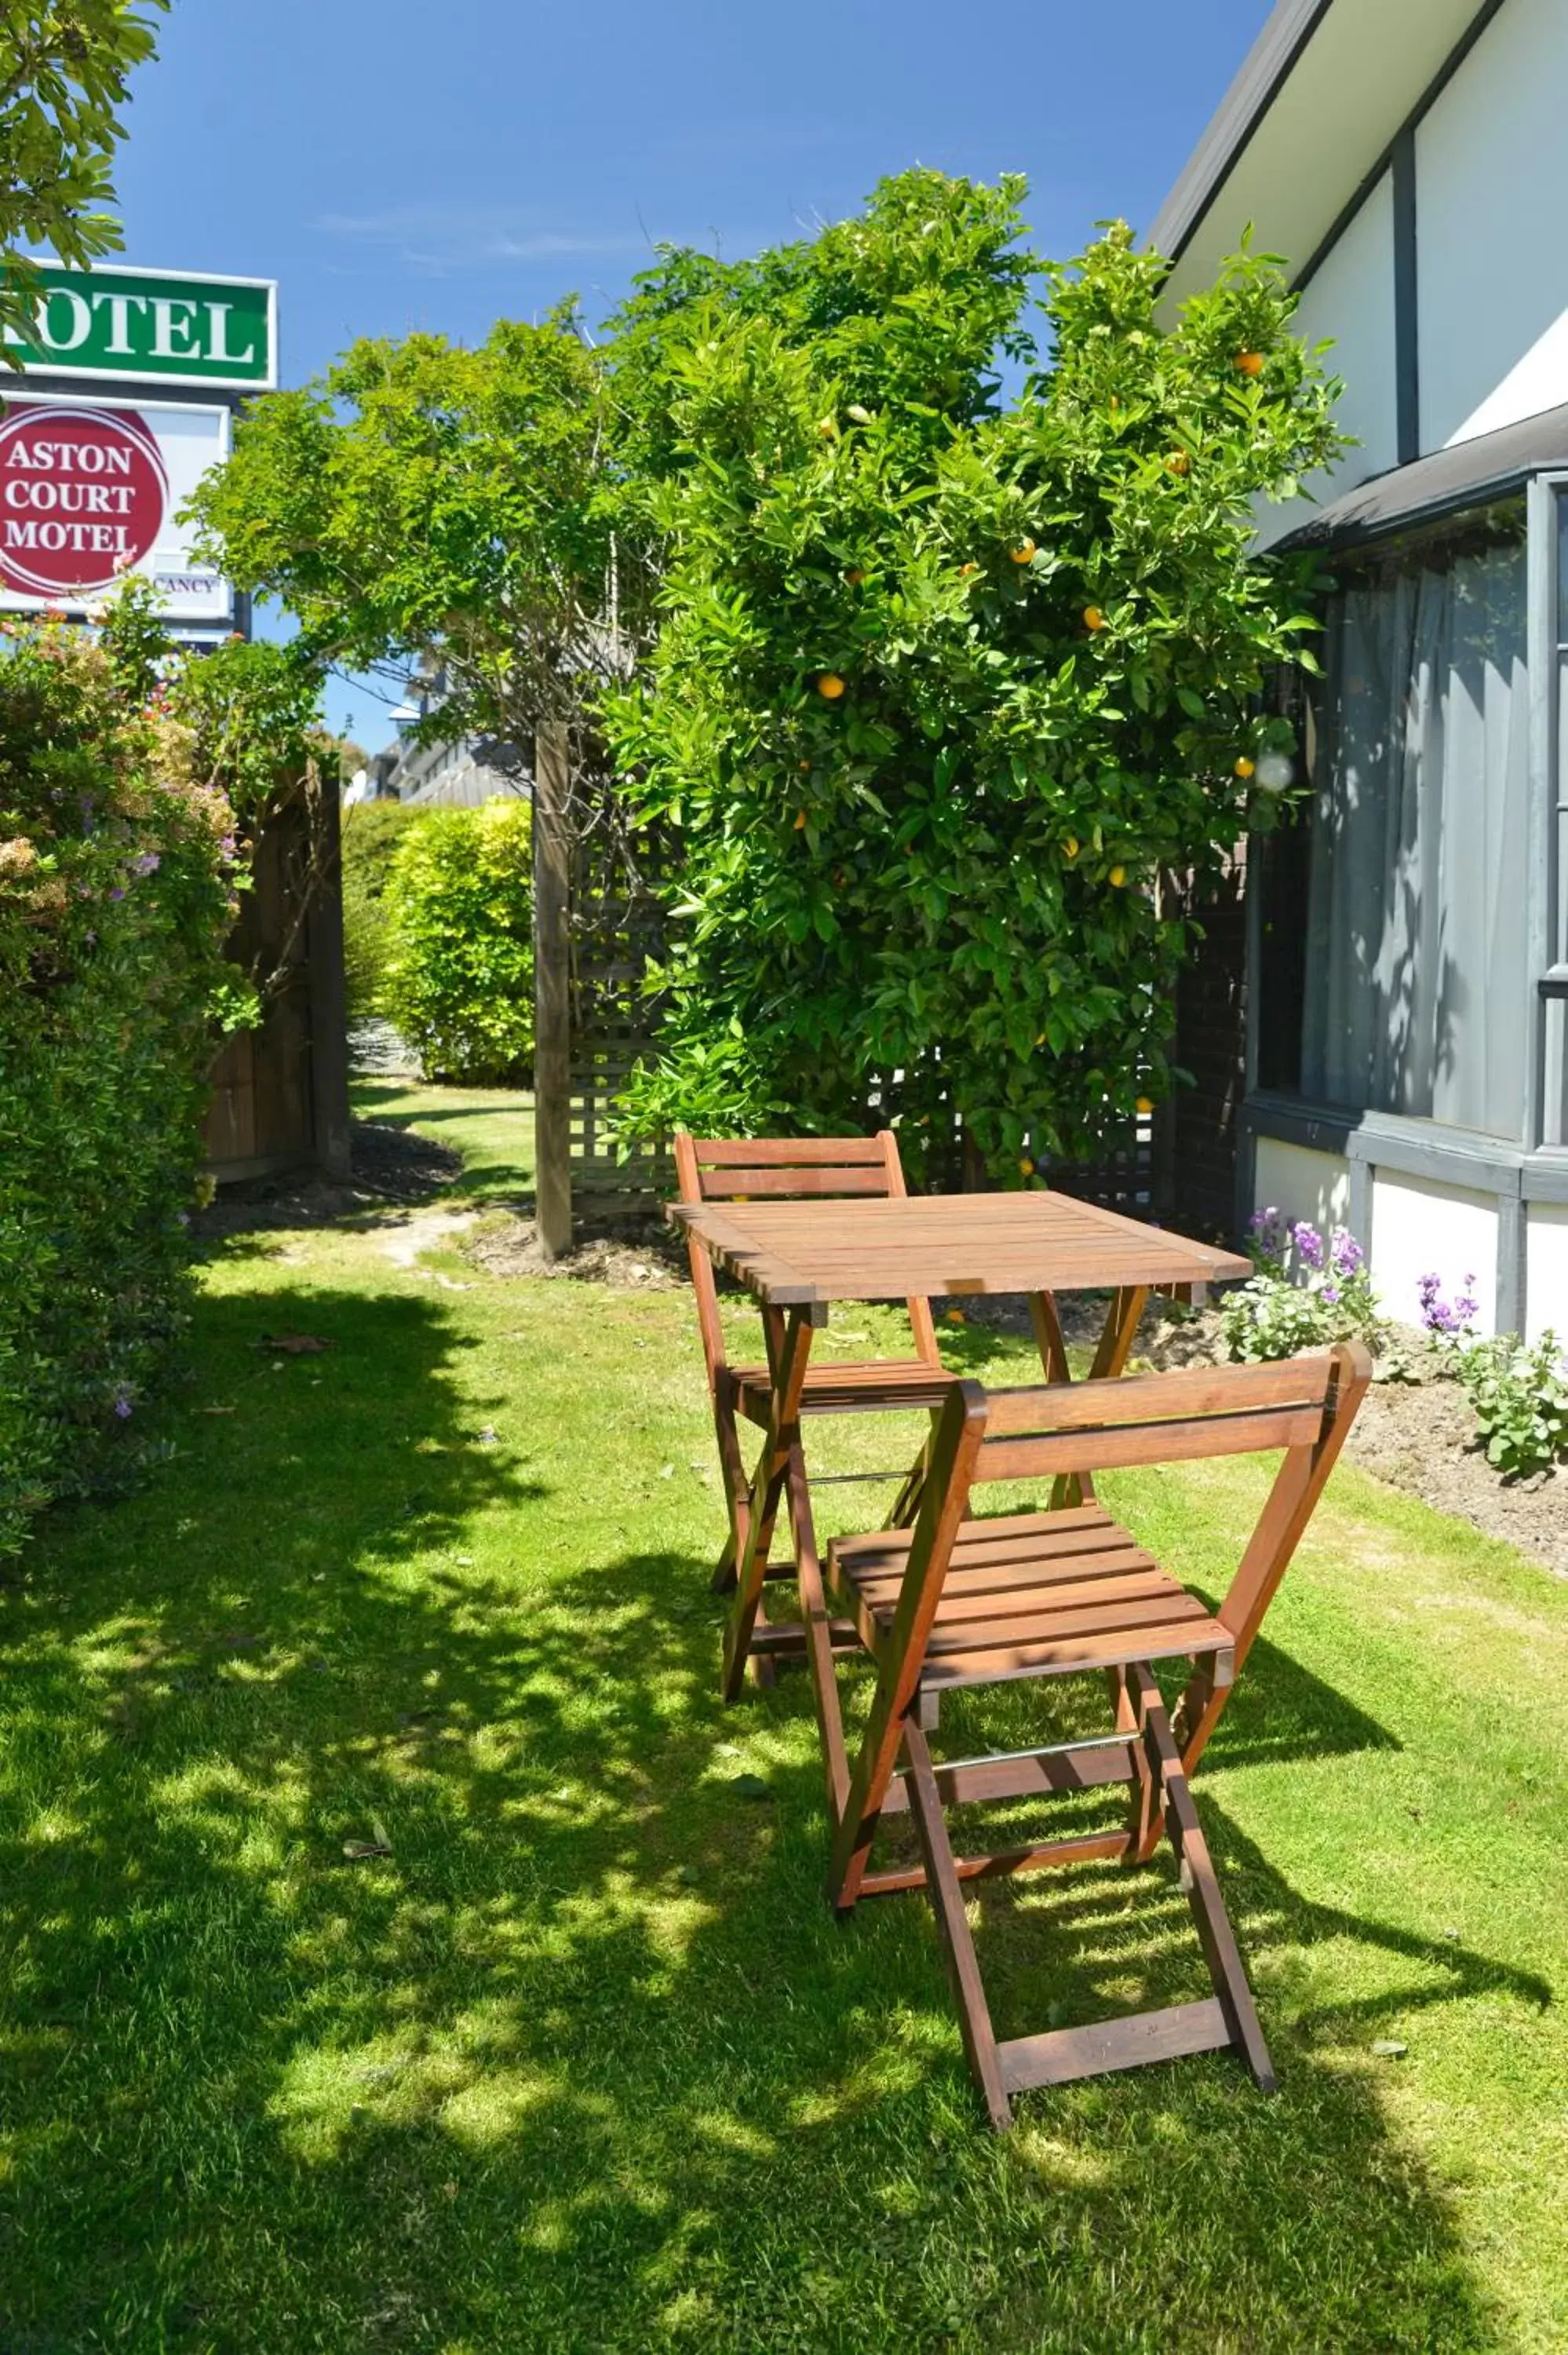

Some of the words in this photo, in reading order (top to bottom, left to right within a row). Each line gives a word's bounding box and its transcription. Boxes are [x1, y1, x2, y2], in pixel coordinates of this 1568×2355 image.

[5, 440, 133, 474] ASTON
[5, 480, 136, 513] COURT
[4, 520, 137, 553] MOTEL
[153, 577, 214, 593] CANCY
